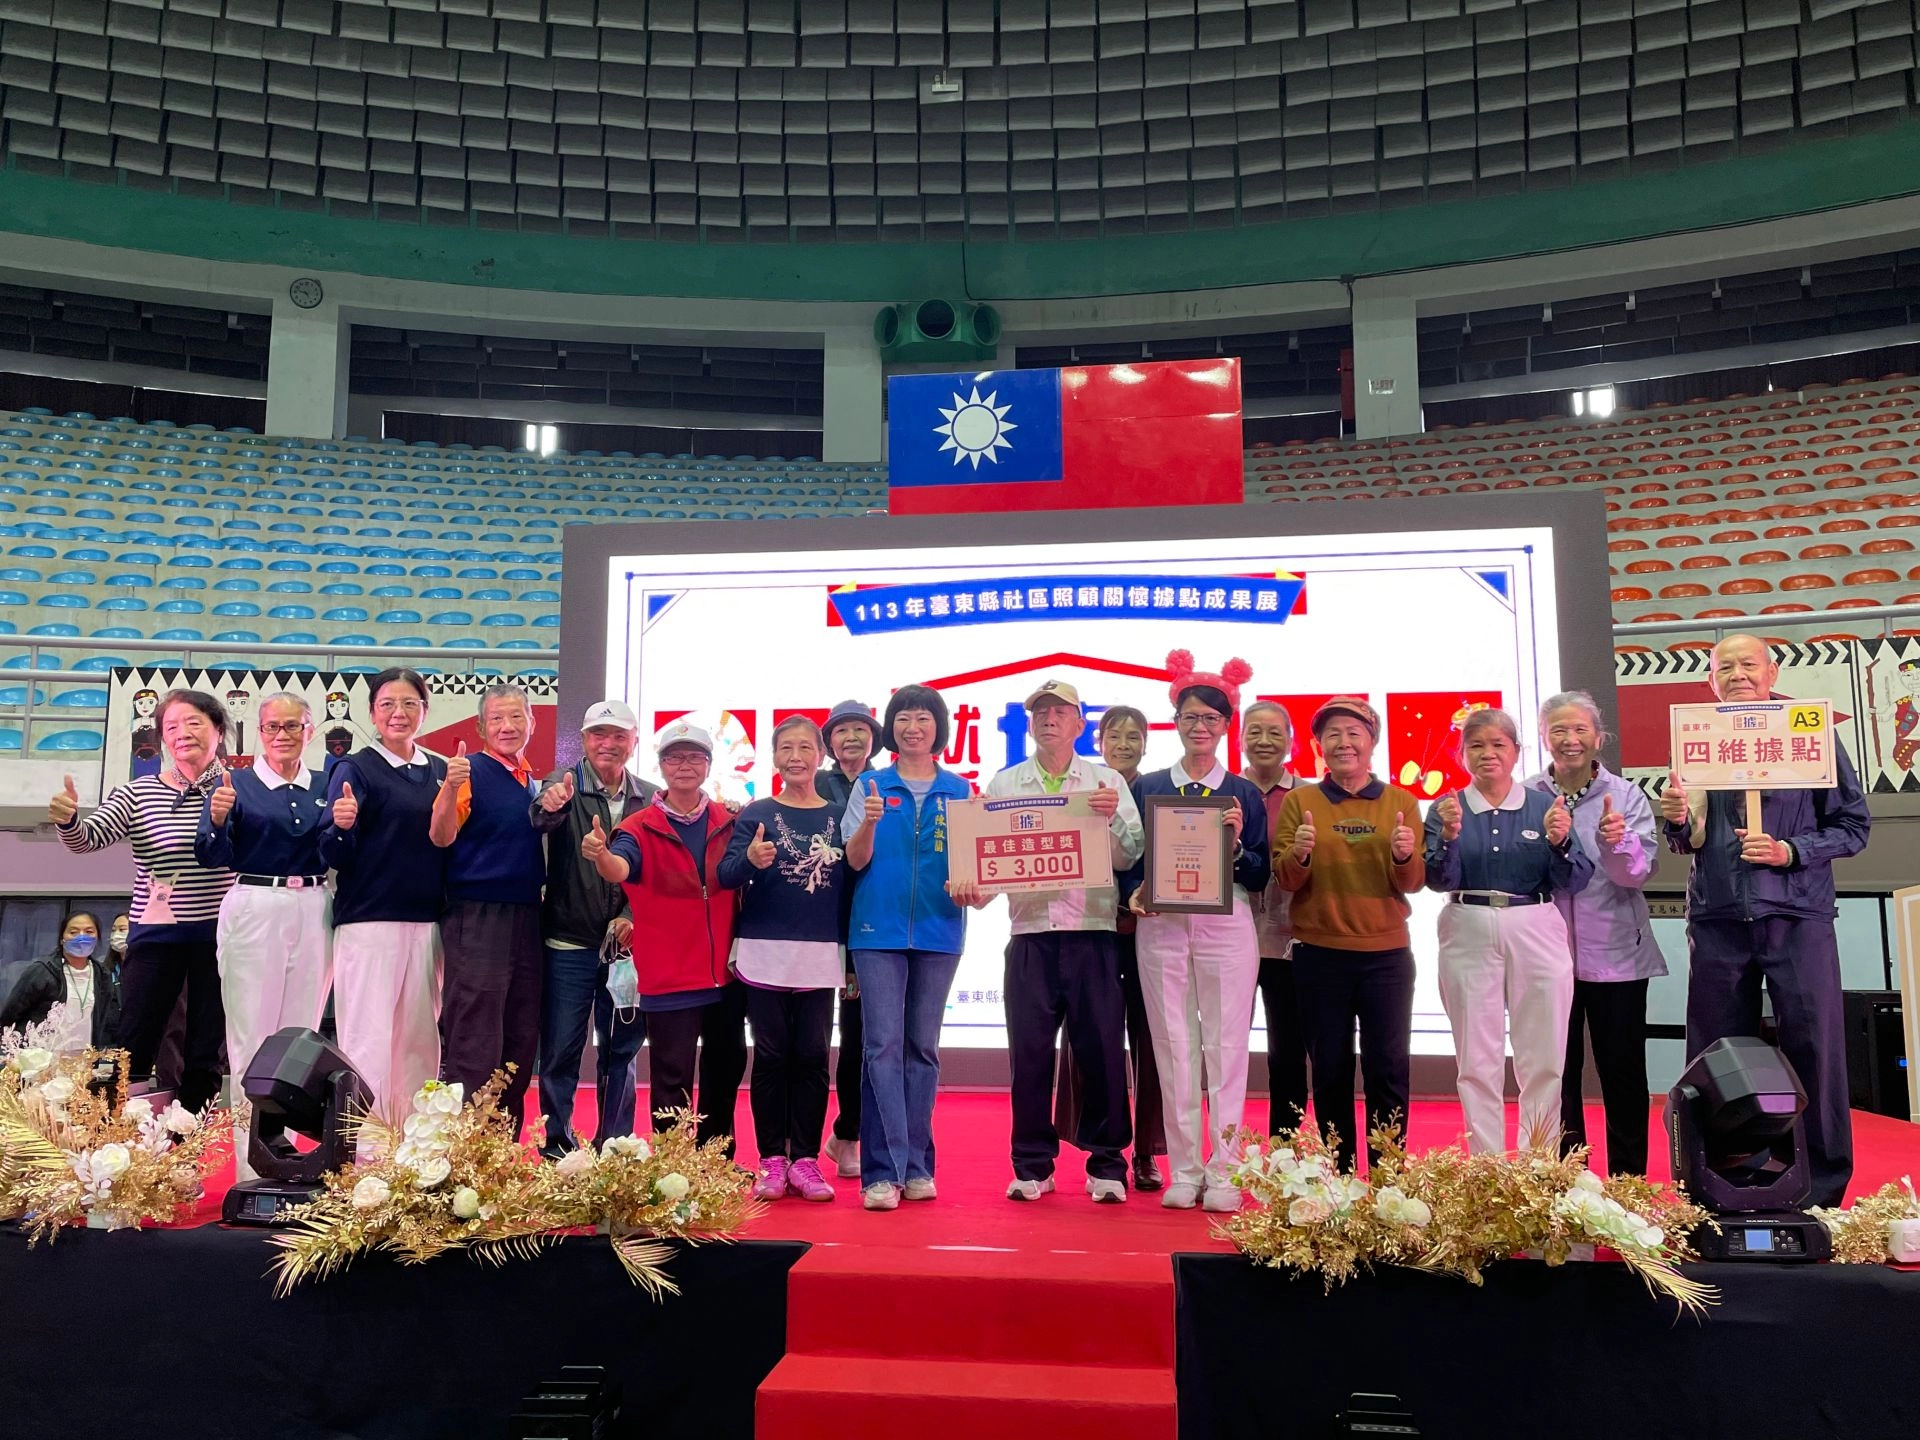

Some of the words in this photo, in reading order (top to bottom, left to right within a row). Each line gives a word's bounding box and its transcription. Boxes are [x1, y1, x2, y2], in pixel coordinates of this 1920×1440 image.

[855, 588, 1280, 622] 113年臺東縣社區照顧關懷據點成果展
[1682, 723, 1711, 732] 臺東市
[1793, 711, 1821, 728] A3
[1683, 736, 1821, 765] 四維據點
[1332, 824, 1377, 834] STUDLY
[983, 835, 1074, 854] 最佳造型獎
[987, 860, 998, 877] $
[1014, 855, 1074, 878] 3,000
